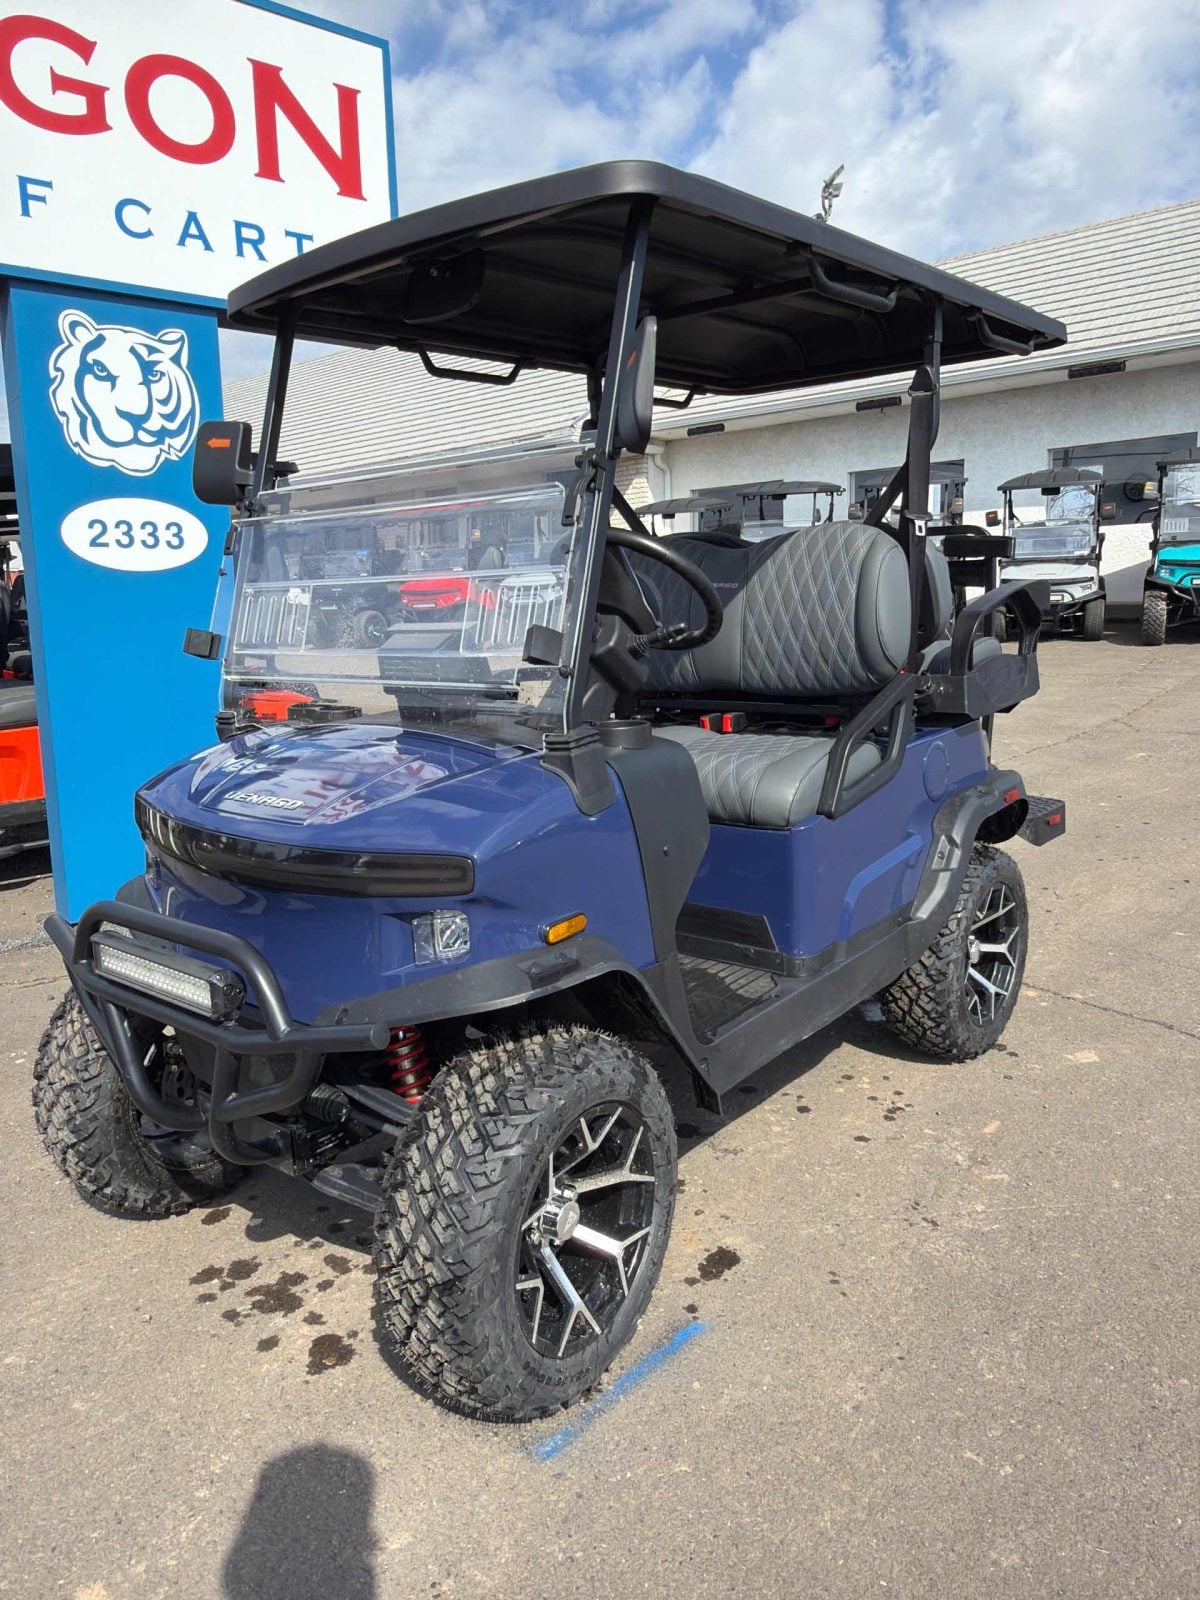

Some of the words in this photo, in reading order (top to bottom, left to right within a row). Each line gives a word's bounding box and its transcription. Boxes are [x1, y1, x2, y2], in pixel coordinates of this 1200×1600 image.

[0, 14, 367, 201] GON
[16, 174, 53, 218] F
[87, 518, 185, 550] 2333
